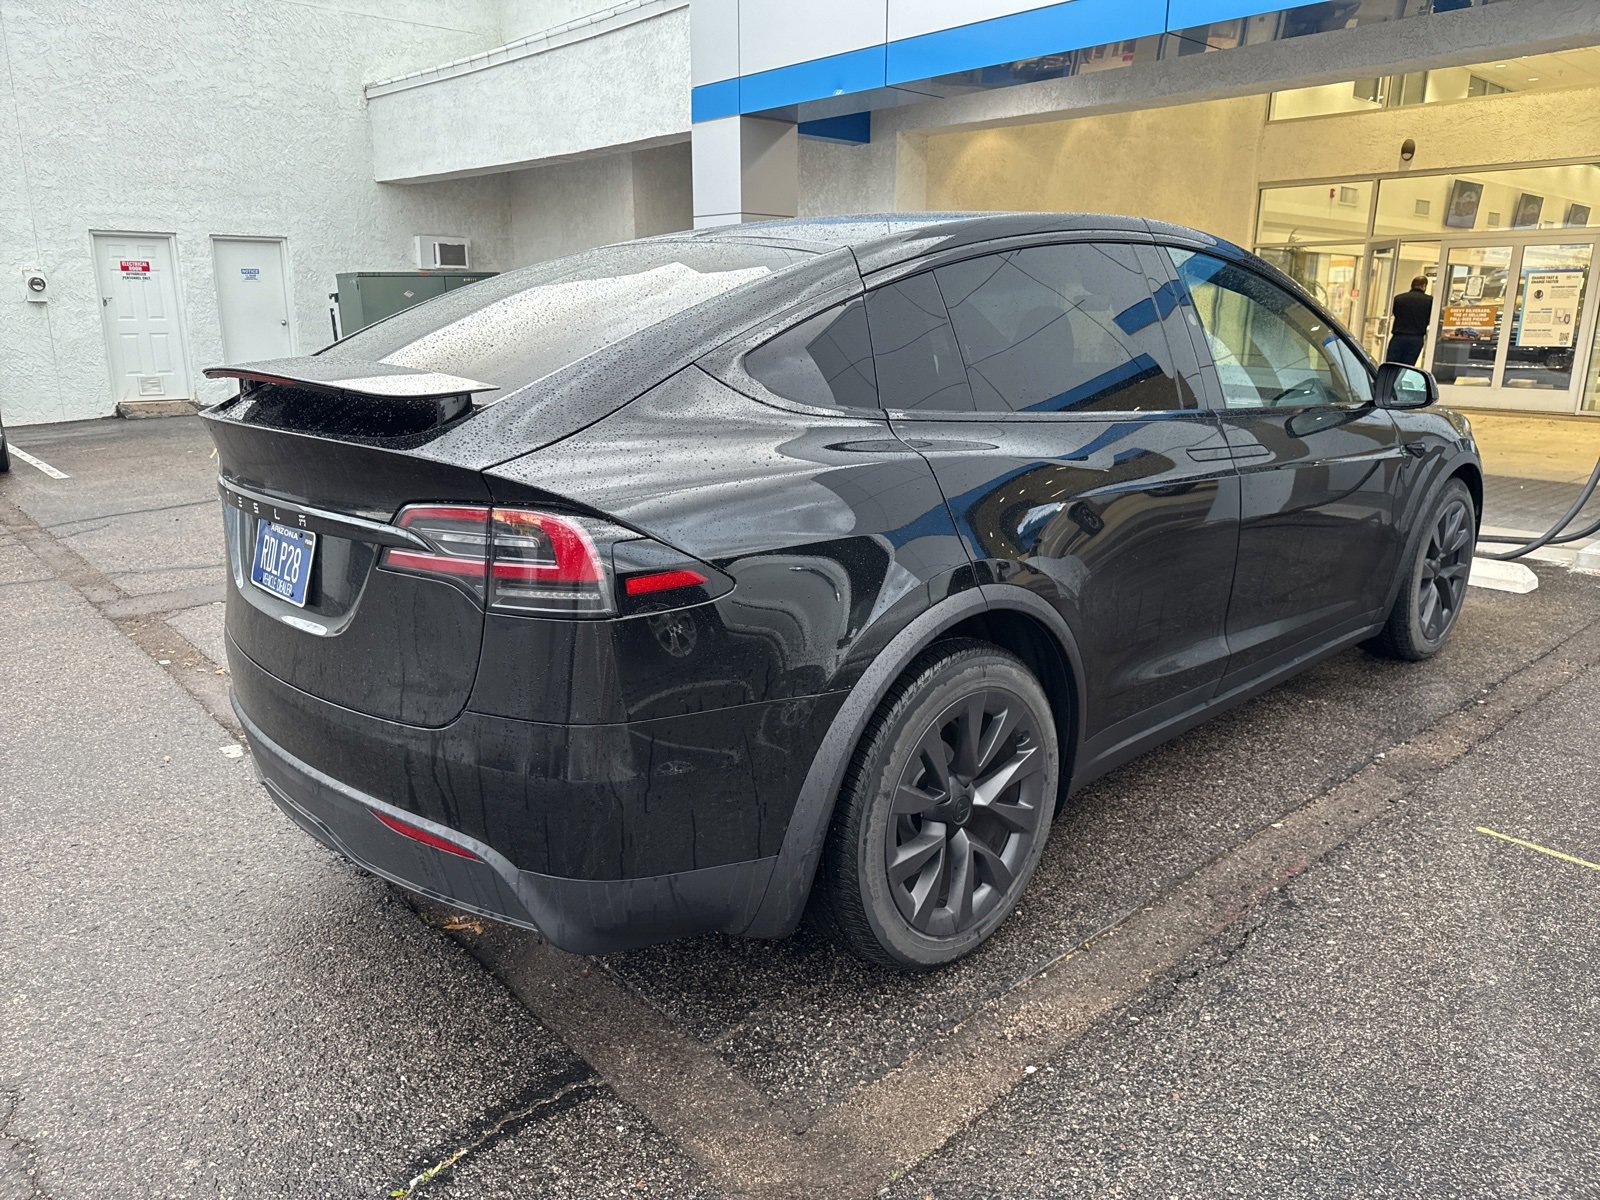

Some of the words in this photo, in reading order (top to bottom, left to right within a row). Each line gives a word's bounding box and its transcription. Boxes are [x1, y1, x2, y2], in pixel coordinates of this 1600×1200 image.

[270, 524, 299, 541] ARIZONA
[260, 534, 302, 584] RDLP28
[262, 571, 277, 590] VEHICLE
[276, 578, 293, 596] DEALER
